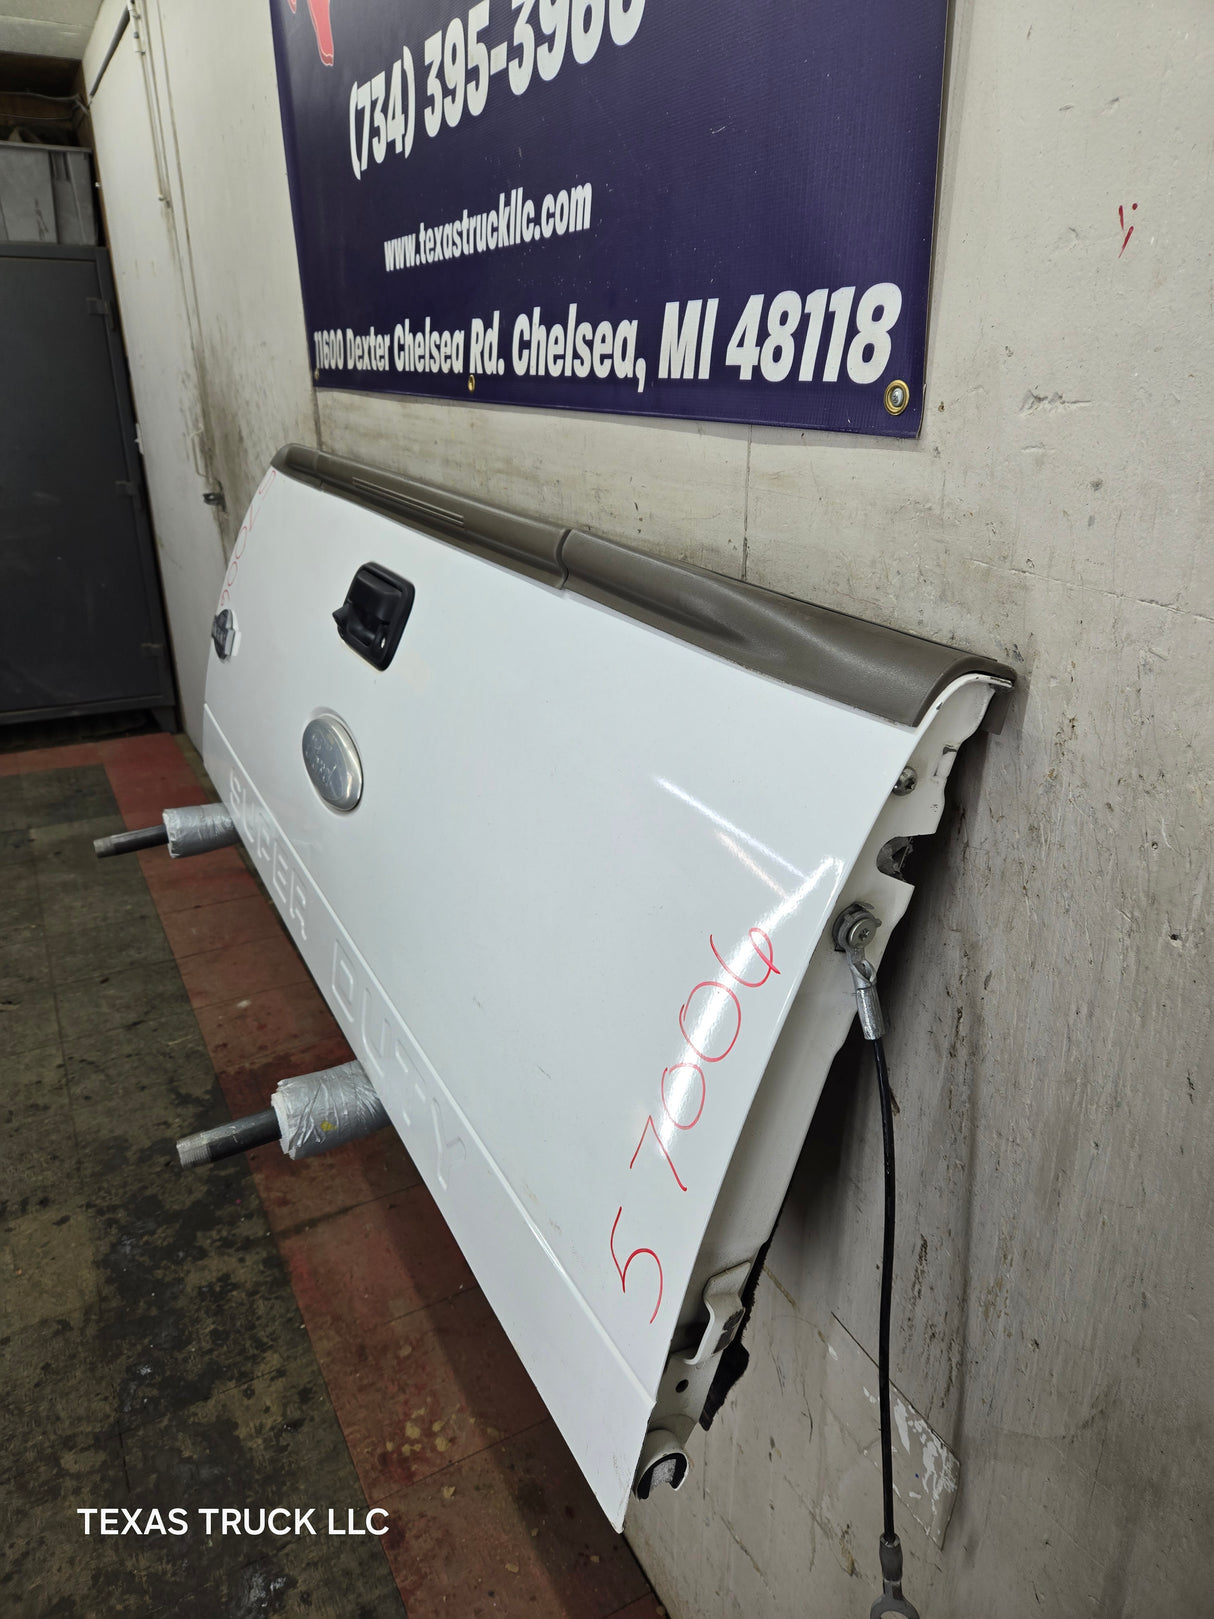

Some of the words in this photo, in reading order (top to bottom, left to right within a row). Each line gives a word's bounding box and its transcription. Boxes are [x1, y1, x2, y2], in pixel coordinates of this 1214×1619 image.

[349, 46, 416, 181] (734)
[384, 182, 593, 271] www.texastruckllc.com
[314, 328, 344, 370] 11600
[346, 325, 391, 372] Dexter
[394, 316, 465, 374] Chelsea
[469, 310, 505, 376] Rd.
[512, 302, 647, 393] Chelsea,
[658, 298, 720, 380] MI
[725, 282, 903, 385] 48118
